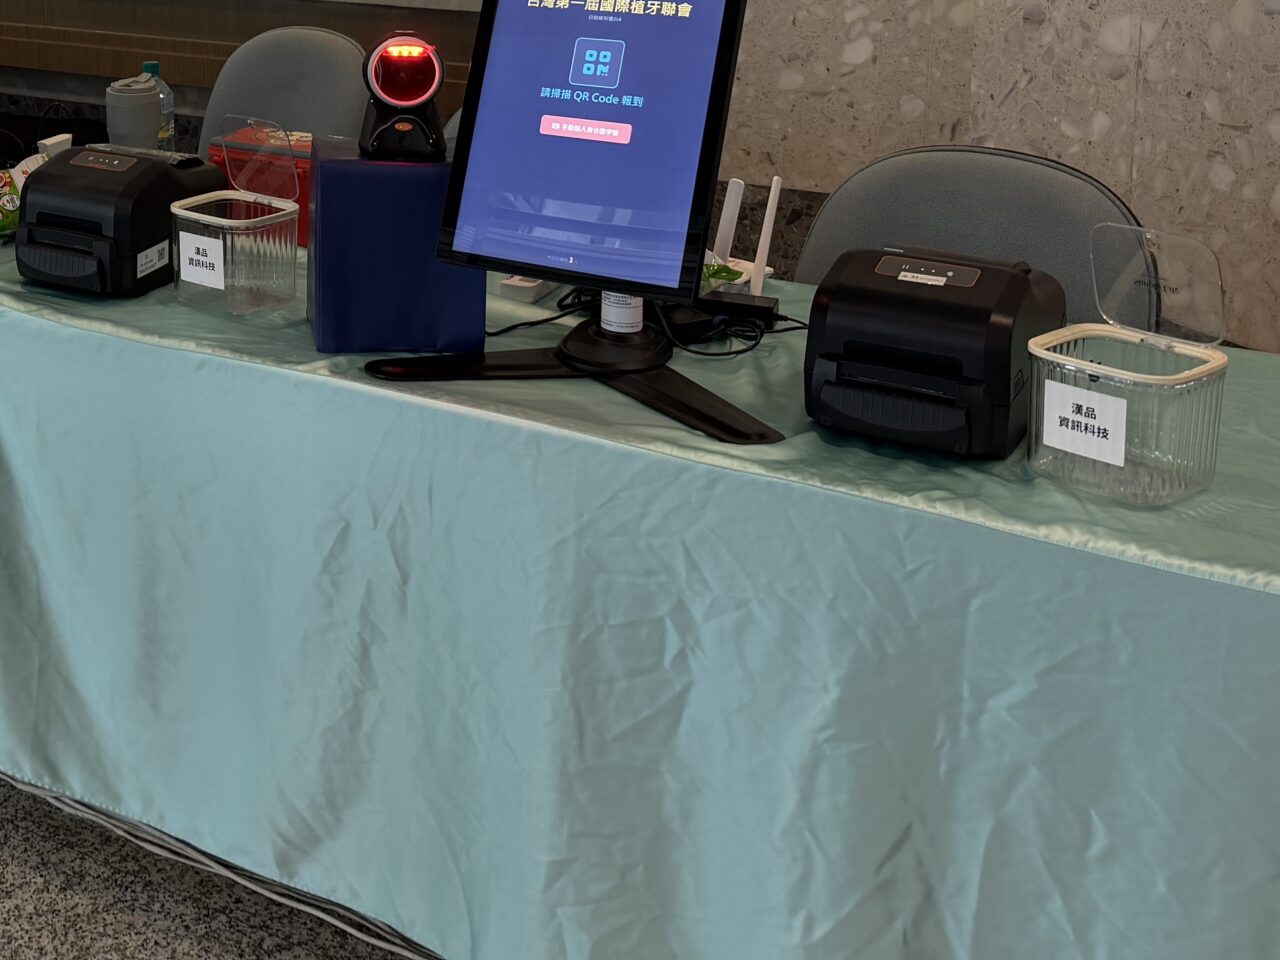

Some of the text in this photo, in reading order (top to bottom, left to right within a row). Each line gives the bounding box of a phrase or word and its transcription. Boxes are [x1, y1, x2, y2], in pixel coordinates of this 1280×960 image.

[540, 87, 644, 108] 請掃描 QR Code 報到
[1071, 402, 1097, 420] 漢品
[1058, 415, 1109, 440] 資訊科技
